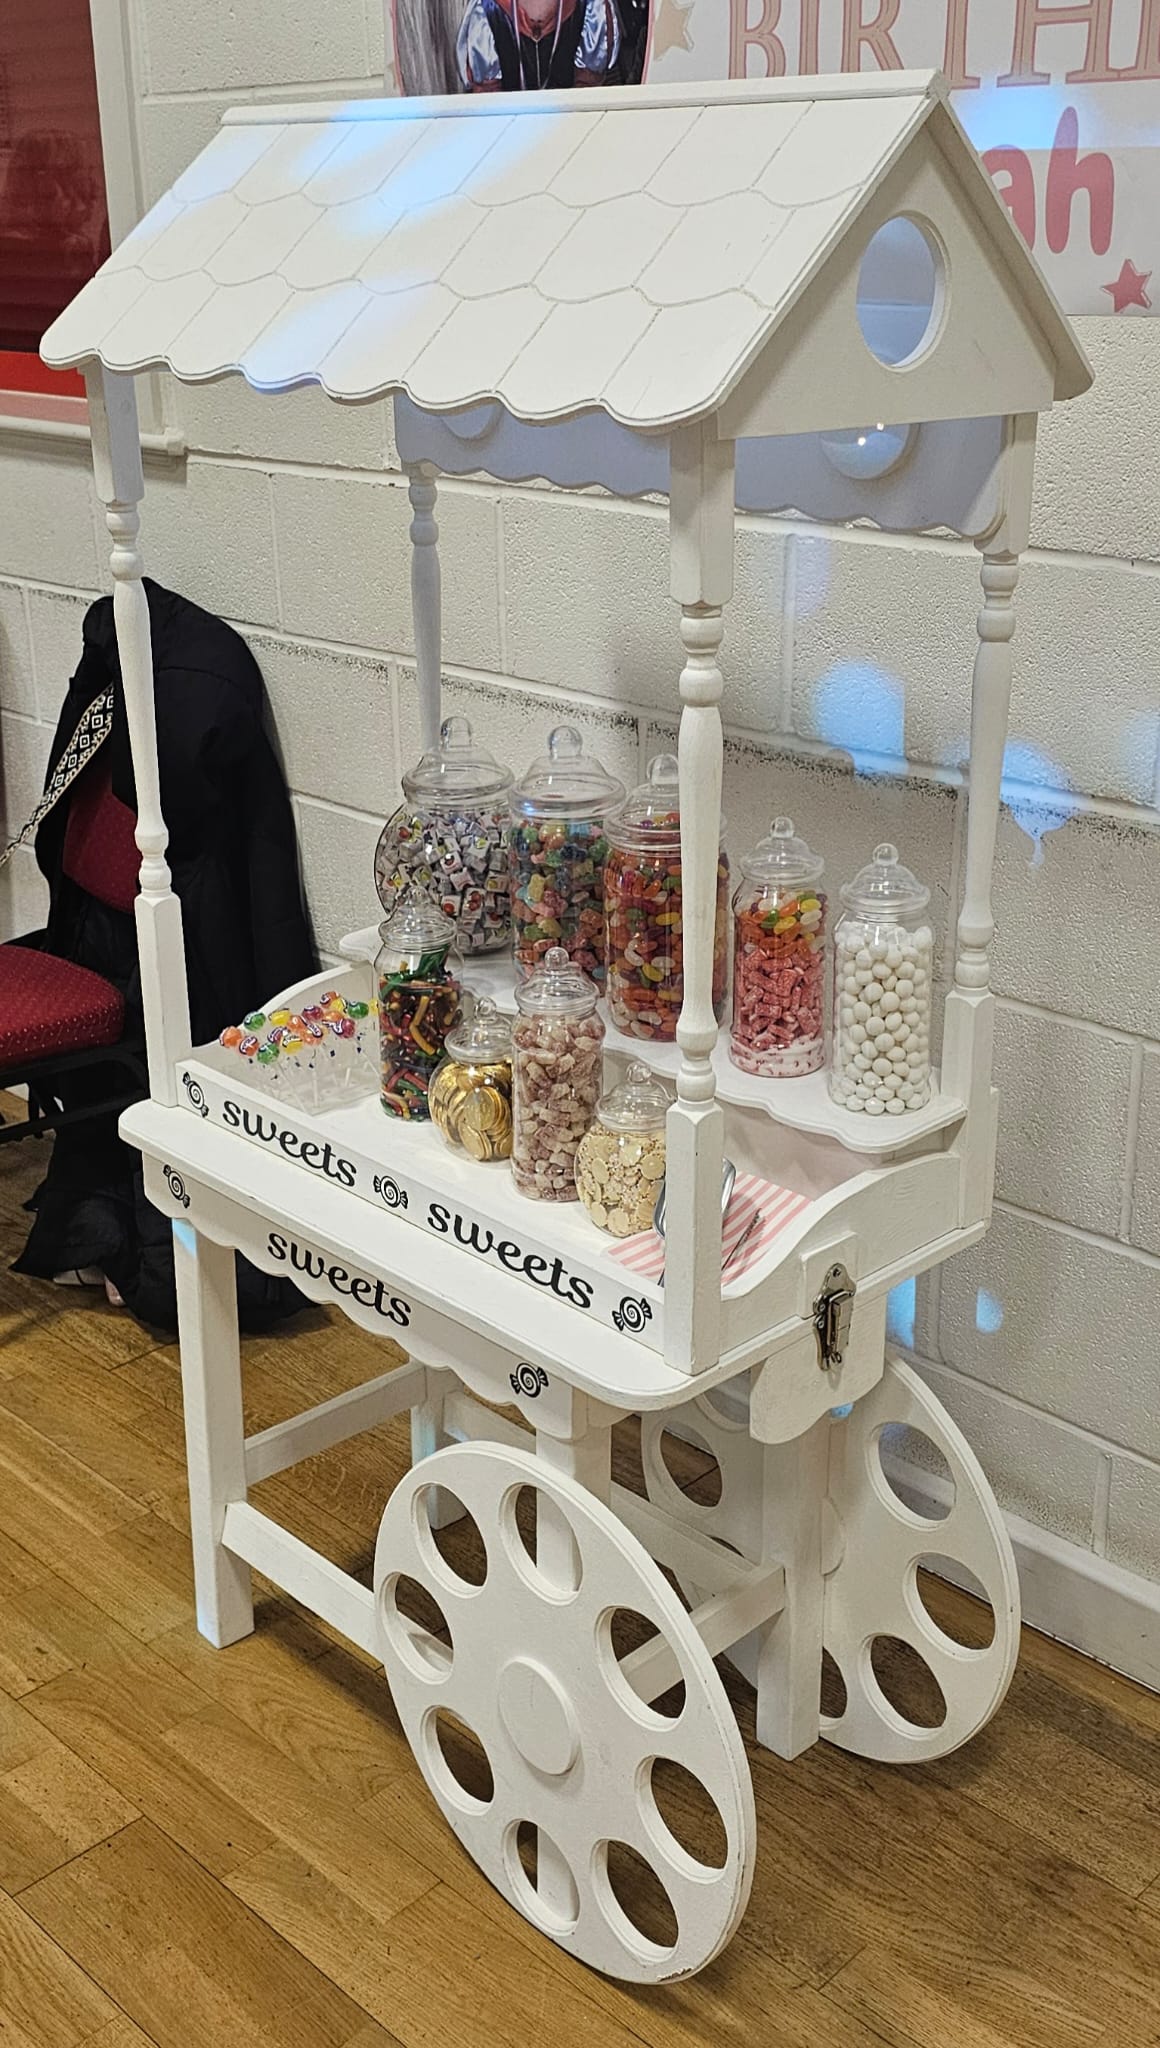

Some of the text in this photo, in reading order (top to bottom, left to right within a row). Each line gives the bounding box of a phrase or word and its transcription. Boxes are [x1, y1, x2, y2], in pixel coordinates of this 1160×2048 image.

[728, 0, 1160, 88] BIRTH
[222, 1100, 594, 1309] sweets sweets
[267, 1232, 412, 1327] sweets
